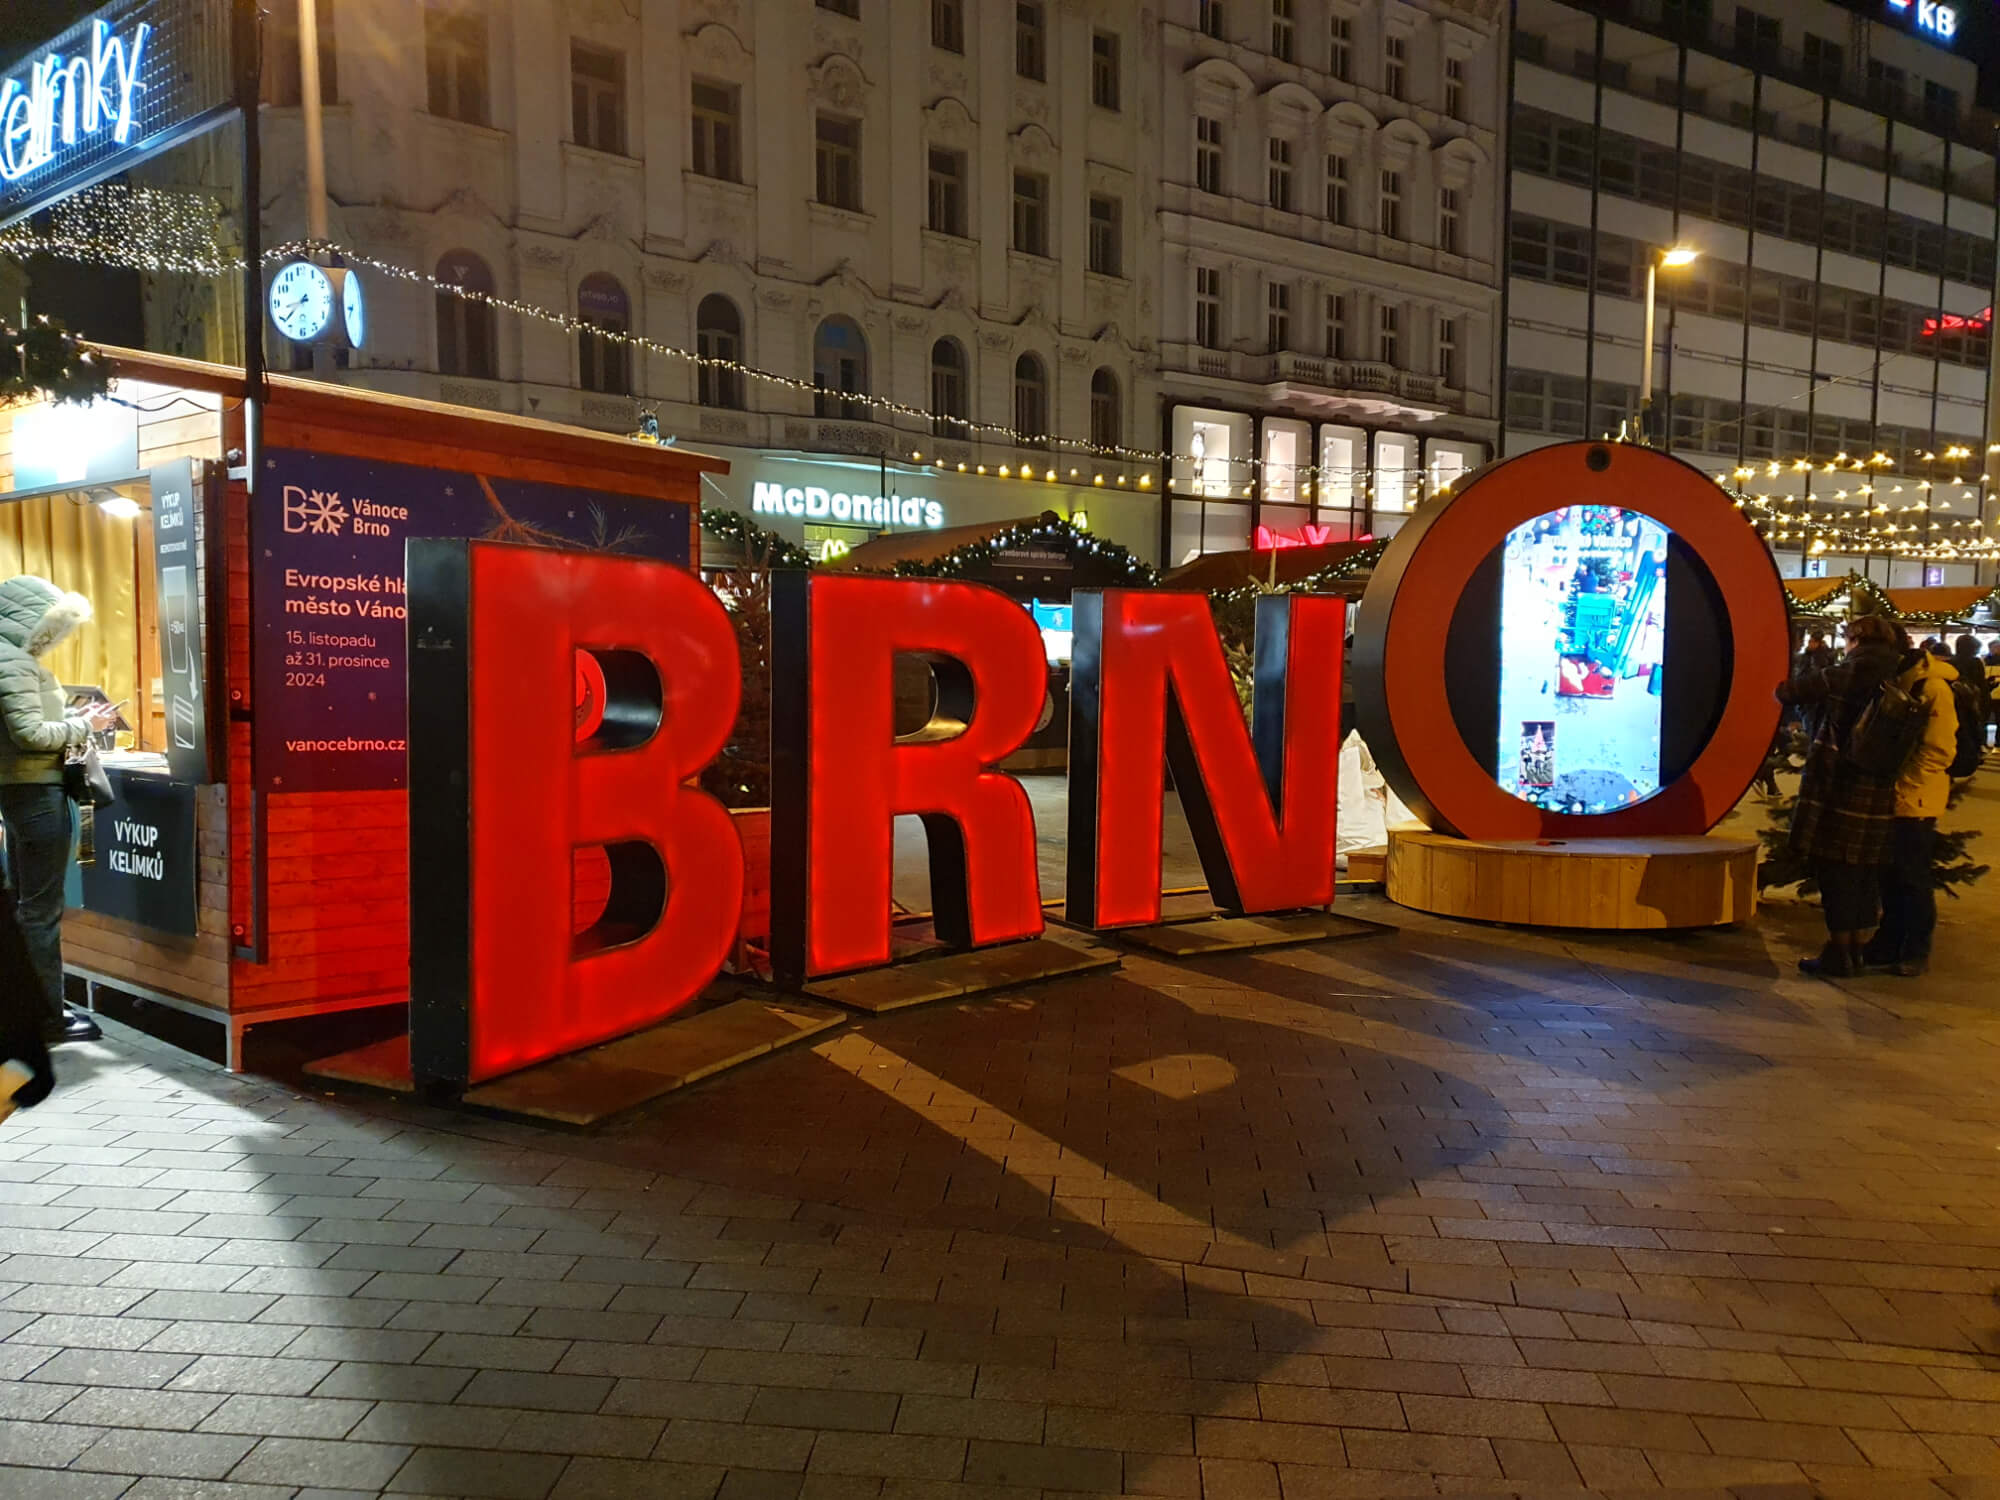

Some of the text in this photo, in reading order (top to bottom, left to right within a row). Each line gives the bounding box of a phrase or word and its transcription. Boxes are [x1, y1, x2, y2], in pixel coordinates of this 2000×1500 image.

[1918, 0, 1957, 35] KB
[352, 498, 408, 520] Vánoce
[752, 482, 945, 529] McDonald's
[353, 517, 390, 536] Brno
[285, 569, 381, 593] Evropské
[285, 595, 407, 619] město Váno
[286, 630, 376, 648] 15. listopadu
[285, 651, 390, 669] až 31. prosince
[285, 672, 326, 687] 2024
[286, 736, 406, 752] vanocebrno.cz
[114, 816, 158, 848] VÝKUP
[109, 848, 164, 881] KELÍMKŮ
